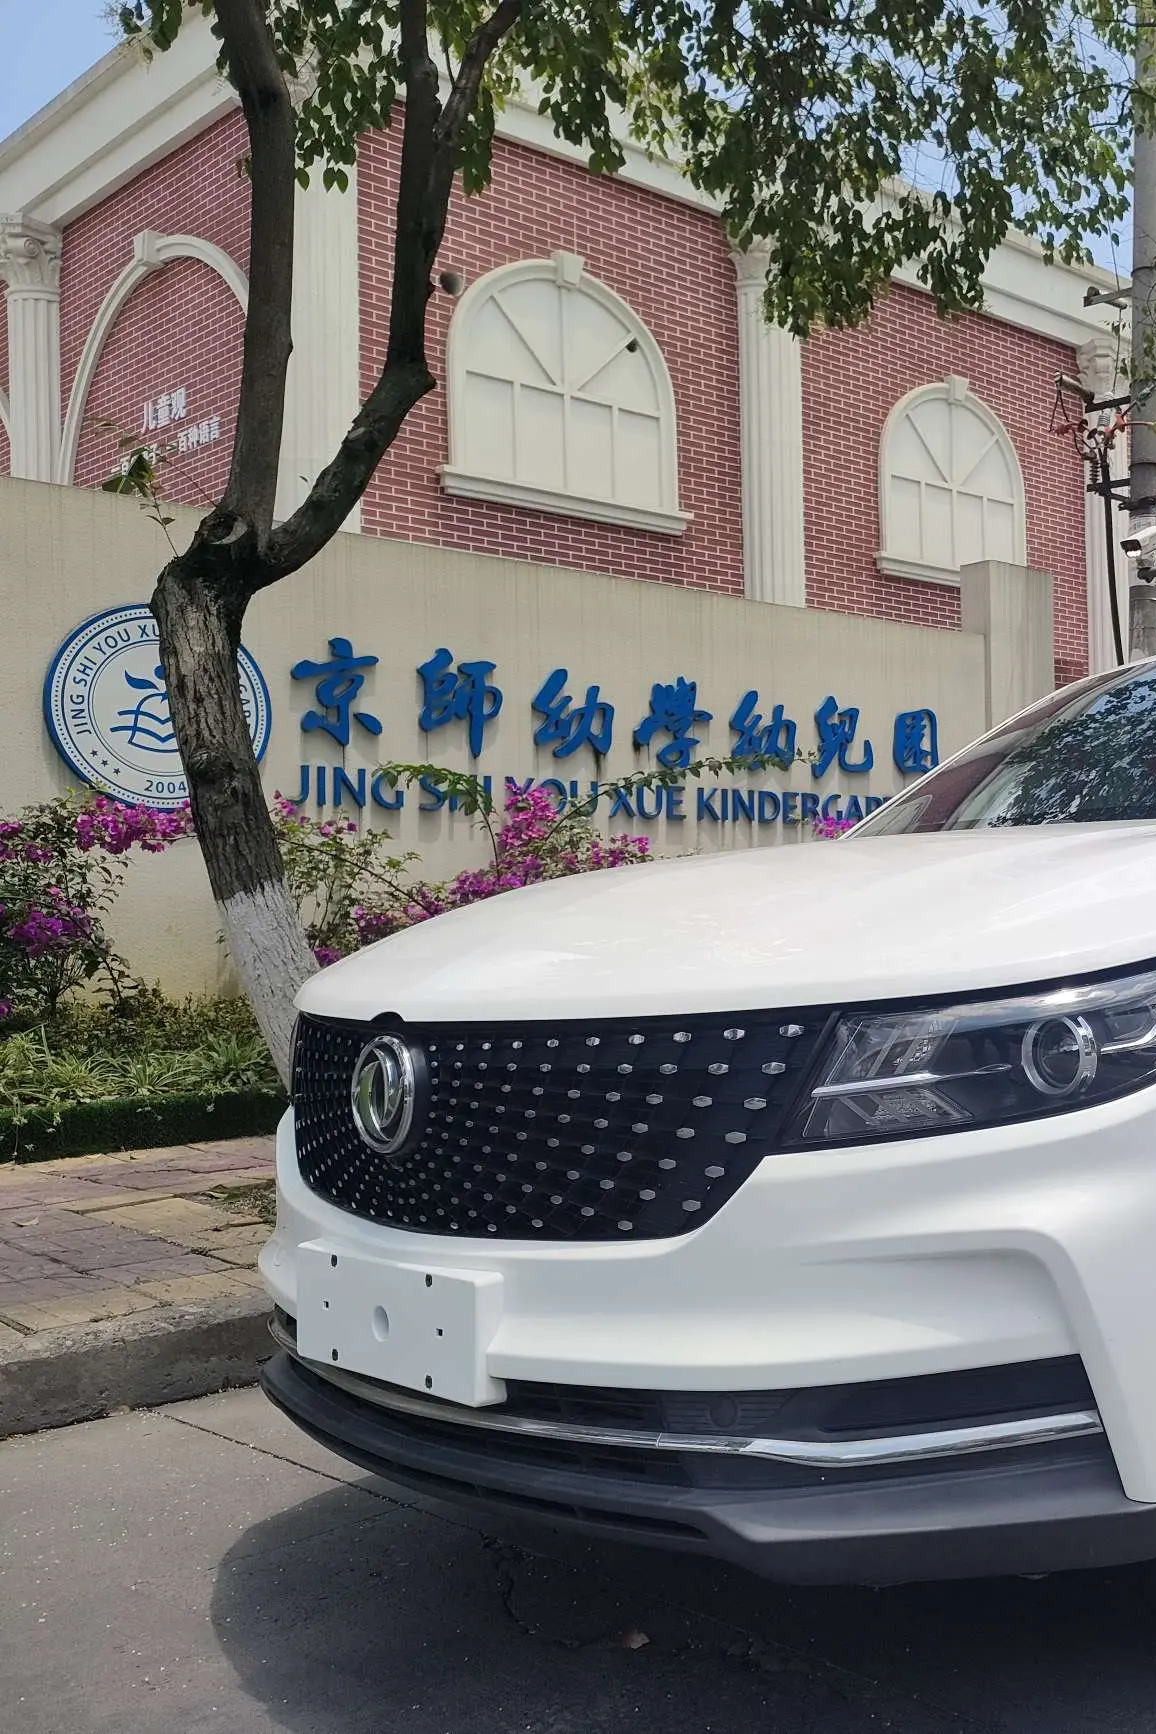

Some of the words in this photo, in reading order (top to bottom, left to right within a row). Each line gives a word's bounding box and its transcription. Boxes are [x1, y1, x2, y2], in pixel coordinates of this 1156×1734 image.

[93, 627, 131, 656] YOU
[73, 656, 97, 687] SHI
[70, 694, 92, 735] JING
[144, 779, 187, 794] 2004
[291, 764, 405, 810] JING
[608, 783, 687, 821] XUE
